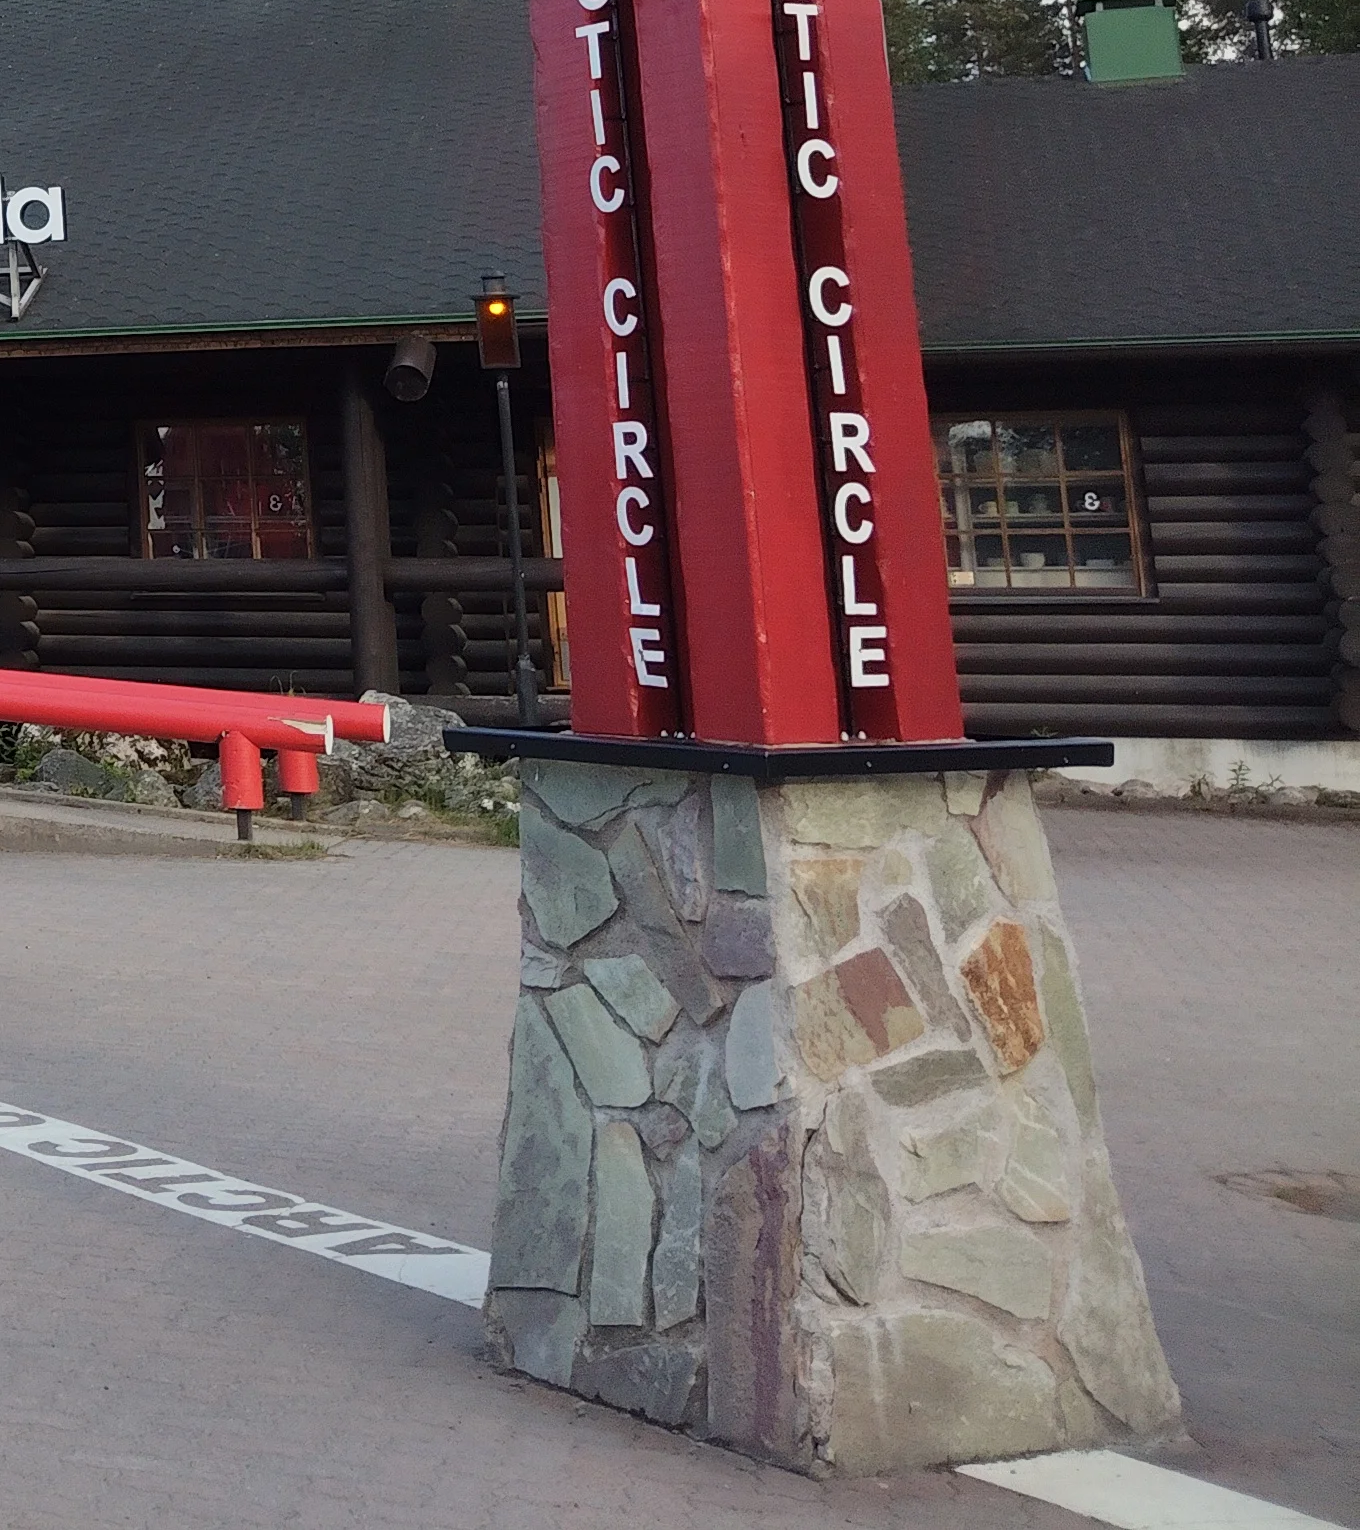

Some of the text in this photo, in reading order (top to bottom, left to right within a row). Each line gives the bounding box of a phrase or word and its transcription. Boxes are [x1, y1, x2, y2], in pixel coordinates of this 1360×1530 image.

[602, 277, 669, 689] CIRCLE
[808, 265, 890, 689] CIRCLE
[27, 1137, 463, 1257] ARCTIC
